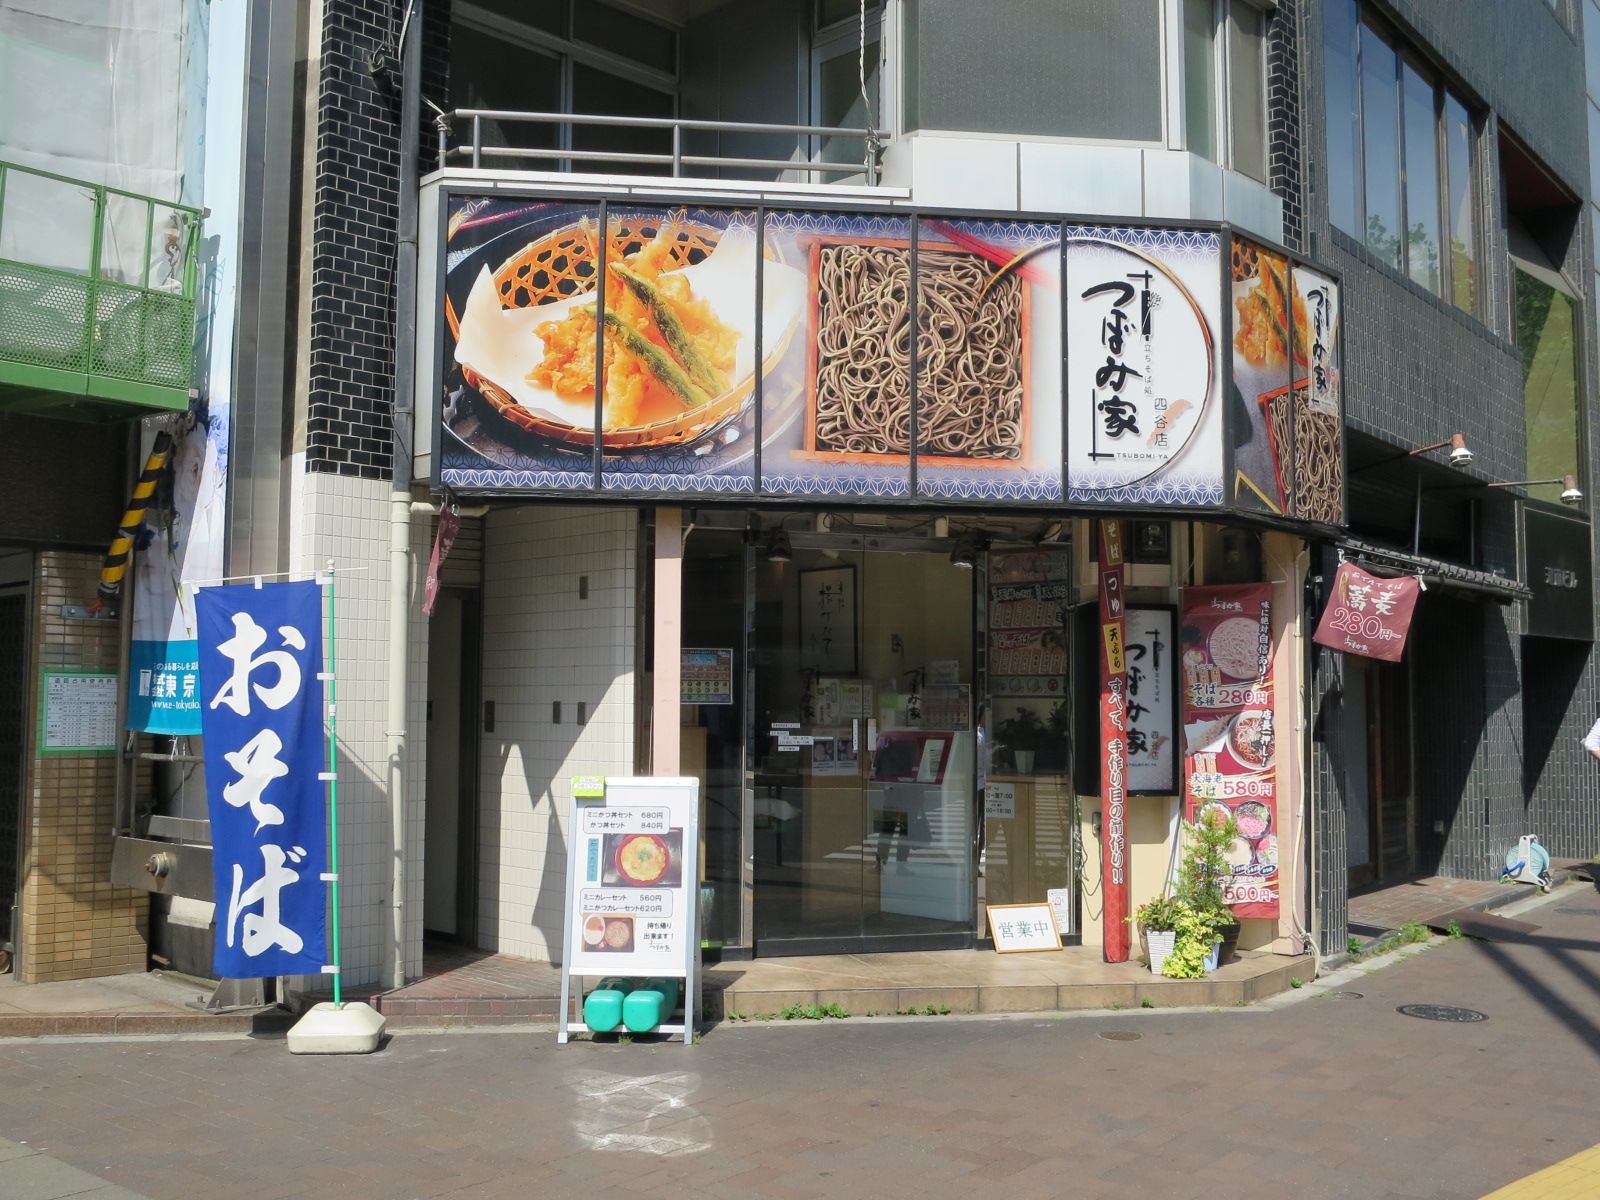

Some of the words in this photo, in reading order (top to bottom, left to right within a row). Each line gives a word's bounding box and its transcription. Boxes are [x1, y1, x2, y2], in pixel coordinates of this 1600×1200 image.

[1307, 289, 1327, 390] つぼみ家
[1081, 281, 1143, 437] つぼみ家
[1144, 344, 1152, 396] 立ちそば処
[1154, 397, 1168, 447] 四谷店
[1107, 522, 1119, 559] そば
[1108, 577, 1120, 612] つゆ
[1346, 584, 1398, 616] 蕎麦
[1109, 627, 1121, 669] 天ぷら
[1193, 683, 1217, 695] そば
[1218, 689, 1268, 705] 280円
[1195, 696, 1215, 706] 各種
[210, 611, 307, 956] おそば
[1193, 774, 1222, 784] 大海老
[1193, 785, 1216, 797] そば
[1223, 780, 1272, 796] 580円
[587, 811, 633, 819] ミニかつ丼セット
[640, 811, 664, 819] 680円
[640, 822, 664, 830] 840円
[583, 893, 627, 901] ミニカレーセット
[639, 894, 662, 902] 560円
[583, 904, 640, 912] ミニかつカレーセット
[998, 919, 1049, 938] 営業中
